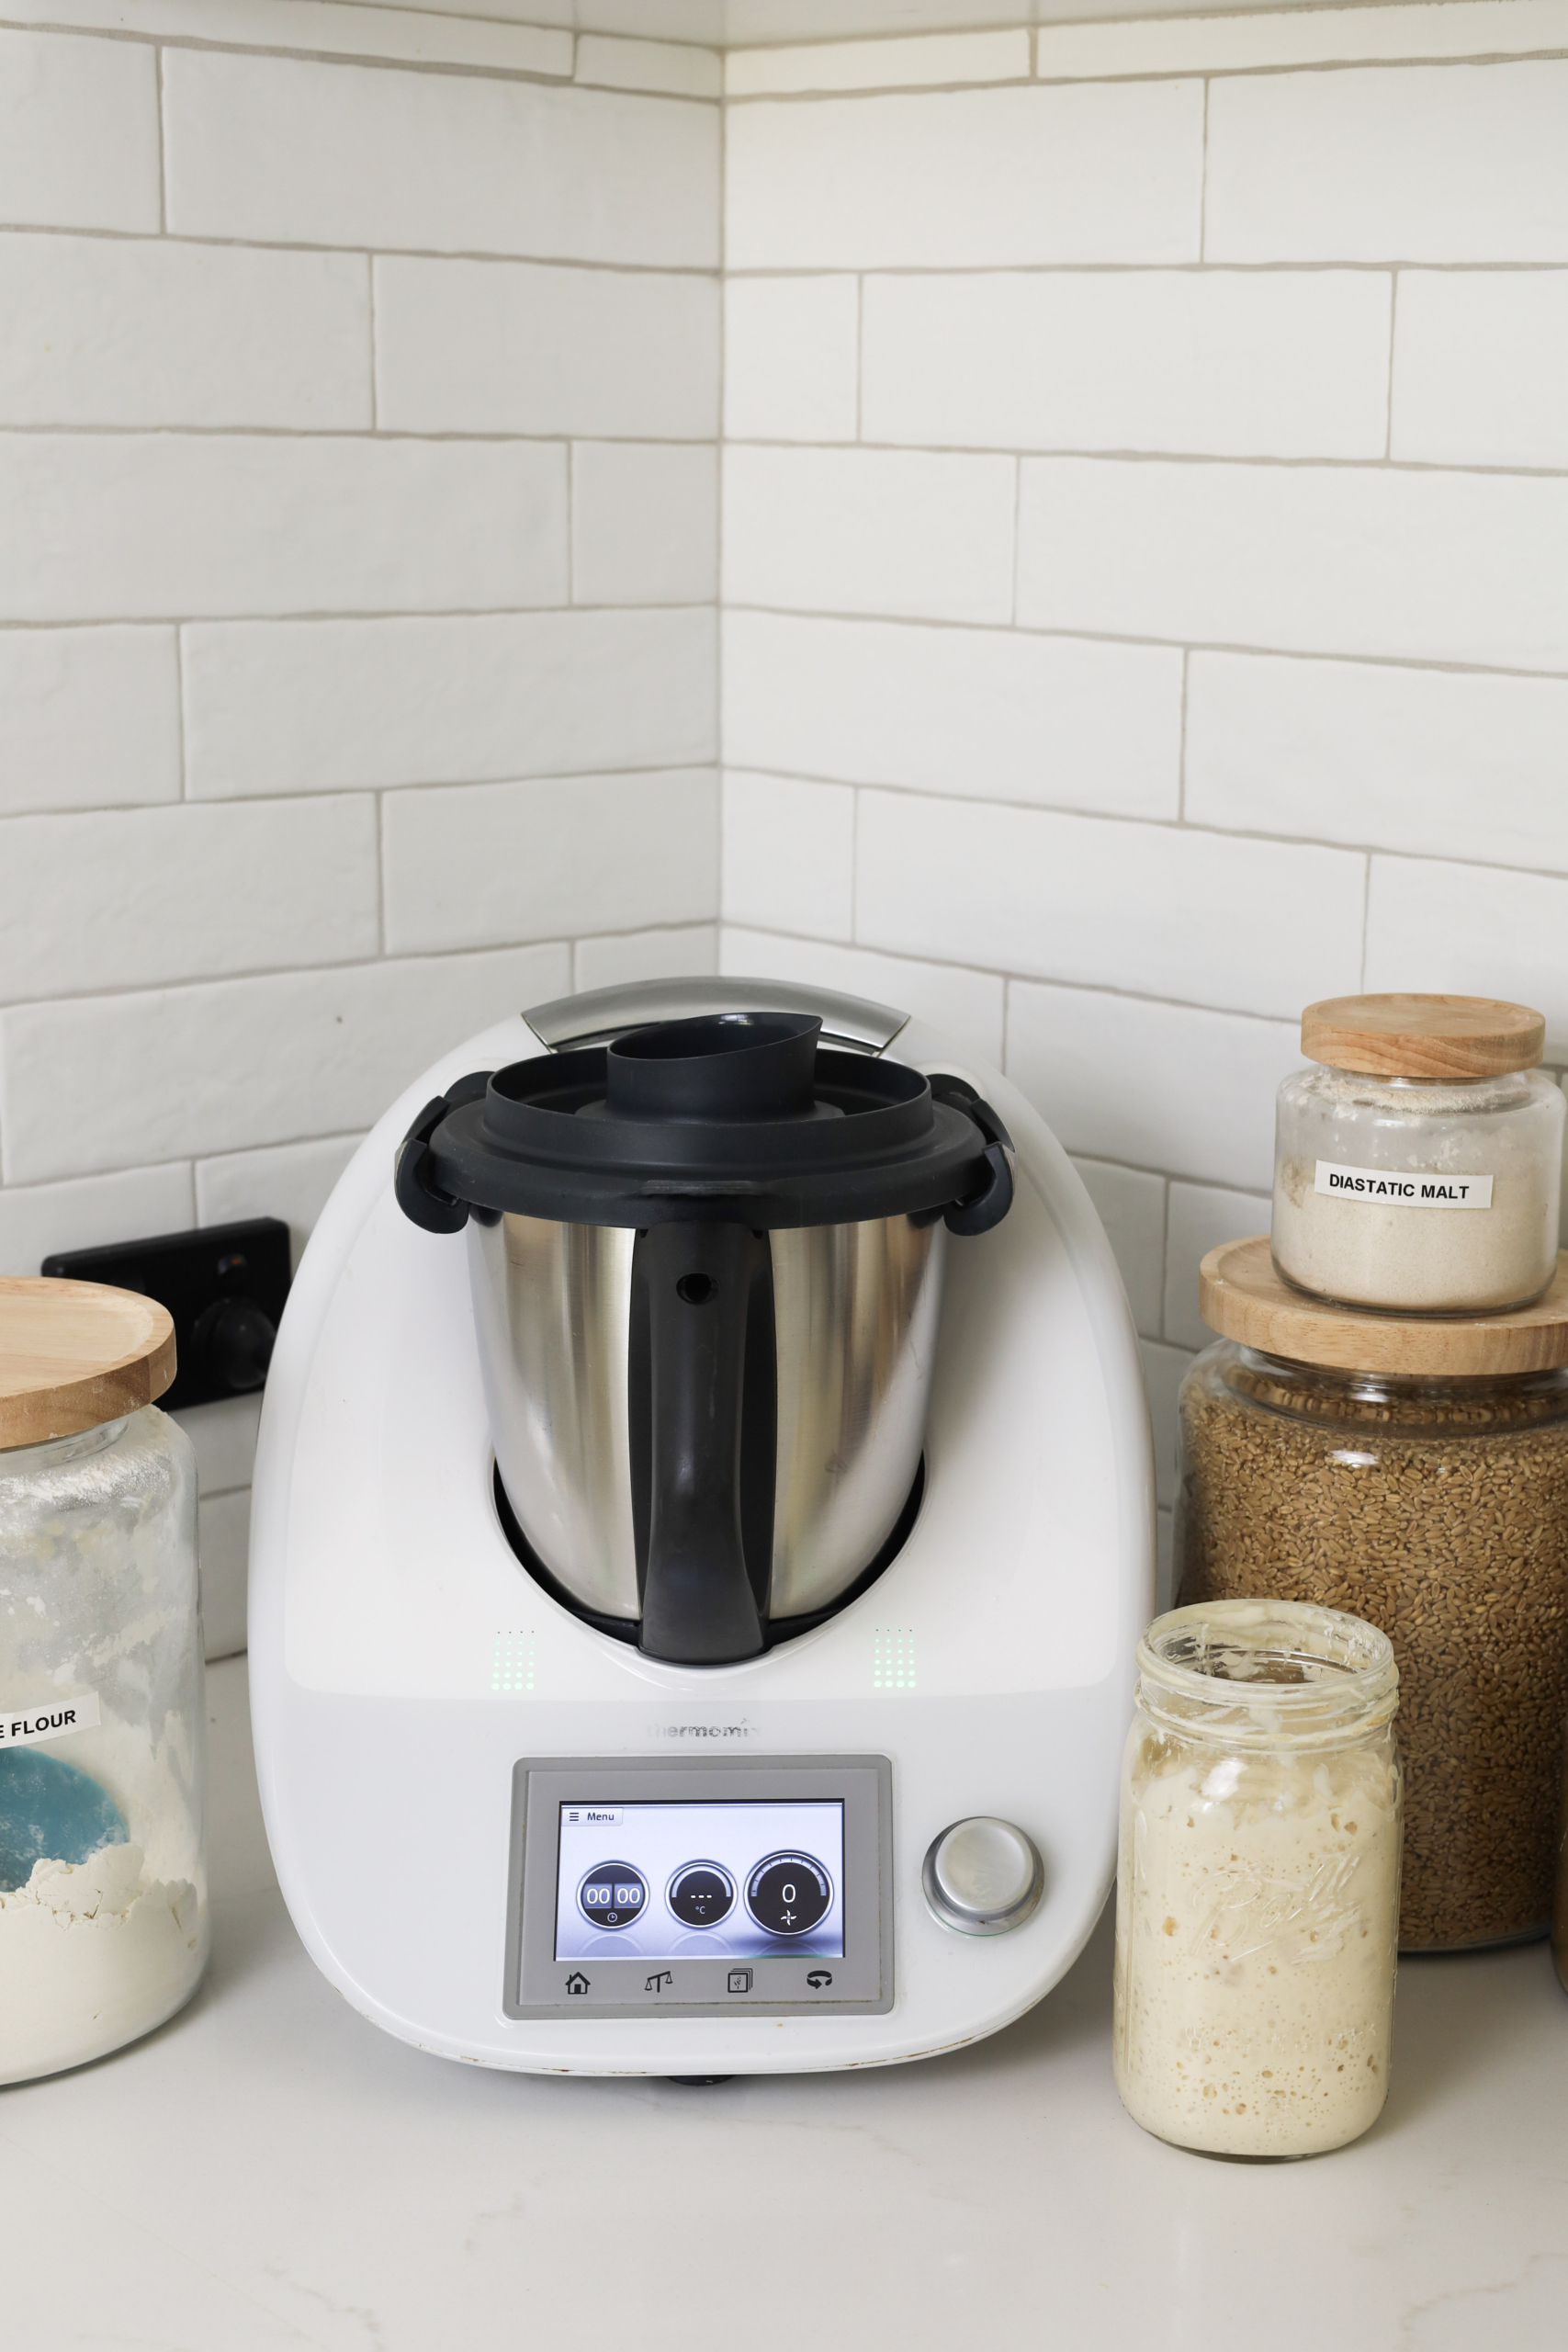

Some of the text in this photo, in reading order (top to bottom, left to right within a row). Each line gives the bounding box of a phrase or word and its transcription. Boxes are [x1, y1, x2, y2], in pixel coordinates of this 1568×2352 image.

[1329, 1173, 1470, 1199] DIASTATIC MALT
[11, 1709, 77, 1737] FLOUR
[587, 1812, 615, 1821] Menu
[586, 1887, 640, 1905] 00 00
[782, 1883, 796, 1904] 0
[694, 1905, 705, 1915] °C
[1189, 1852, 1361, 1960] Ball
